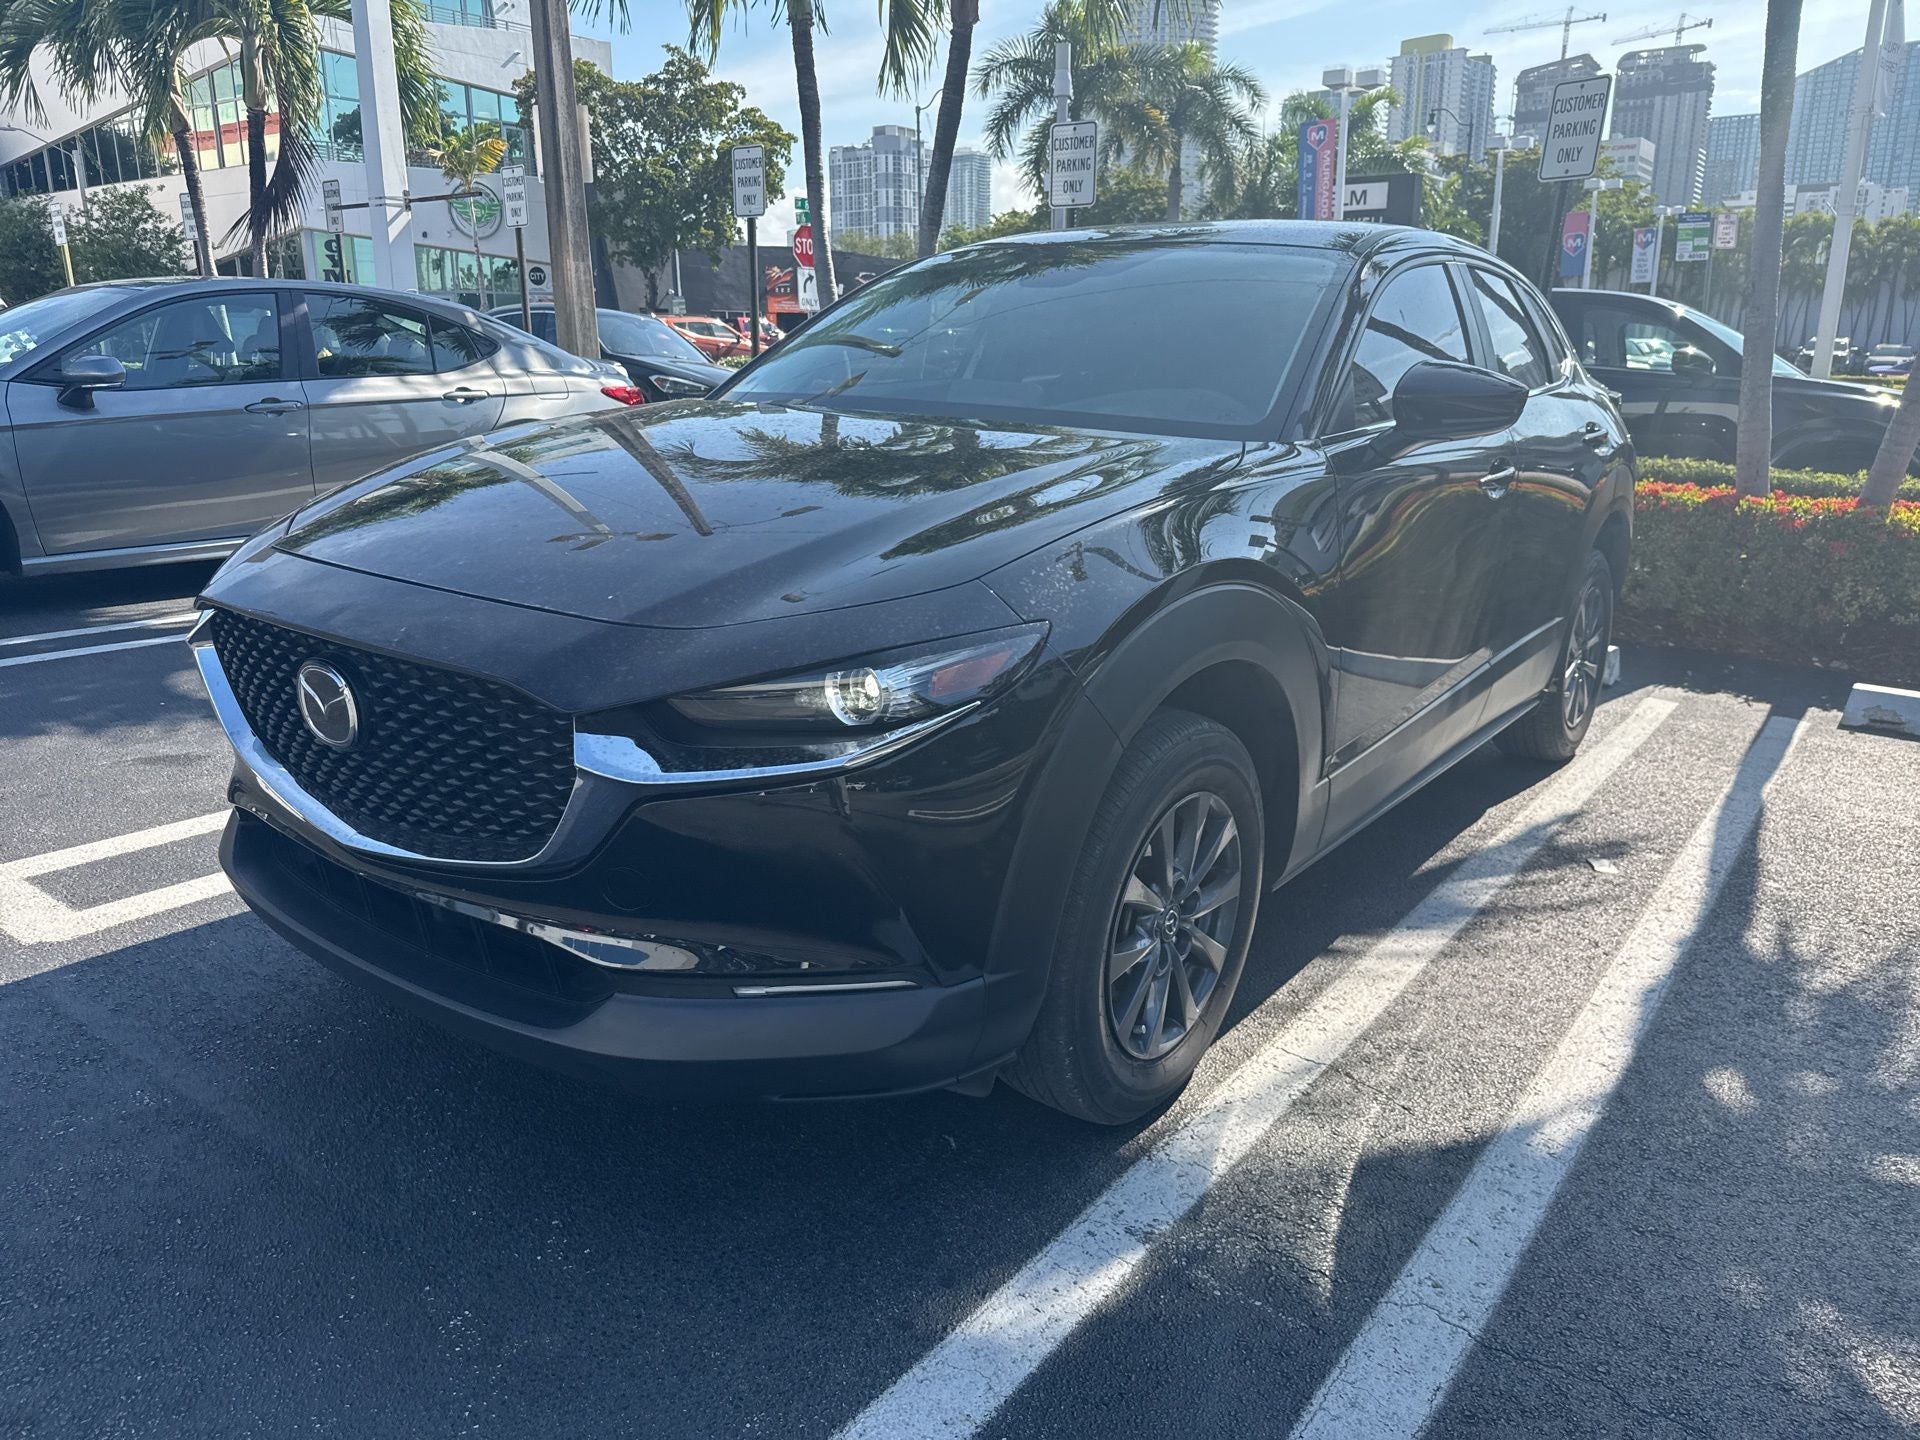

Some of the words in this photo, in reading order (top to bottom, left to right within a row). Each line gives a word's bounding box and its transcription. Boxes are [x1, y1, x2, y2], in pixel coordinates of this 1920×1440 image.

[1553, 93, 1606, 114] CUSTOMER
[1310, 130, 1324, 140] M
[1552, 119, 1597, 139] PARKING
[1054, 135, 1094, 151] CUSTOMER
[1557, 146, 1583, 163] ONLY
[735, 157, 762, 170] CUSTOMER
[1056, 157, 1091, 172] PARKING
[503, 175, 524, 187] CUSTOMER
[737, 175, 761, 188] PARKING
[1063, 179, 1083, 193] ONLY
[1320, 149, 1331, 219] MURGADO
[506, 191, 524, 202] PARKING
[743, 194, 757, 206] ONLY
[511, 207, 521, 218] ONLY
[1566, 238, 1581, 248] M
[1636, 233, 1652, 243] M
[795, 237, 813, 255] STO
[801, 297, 819, 307] ONLY
